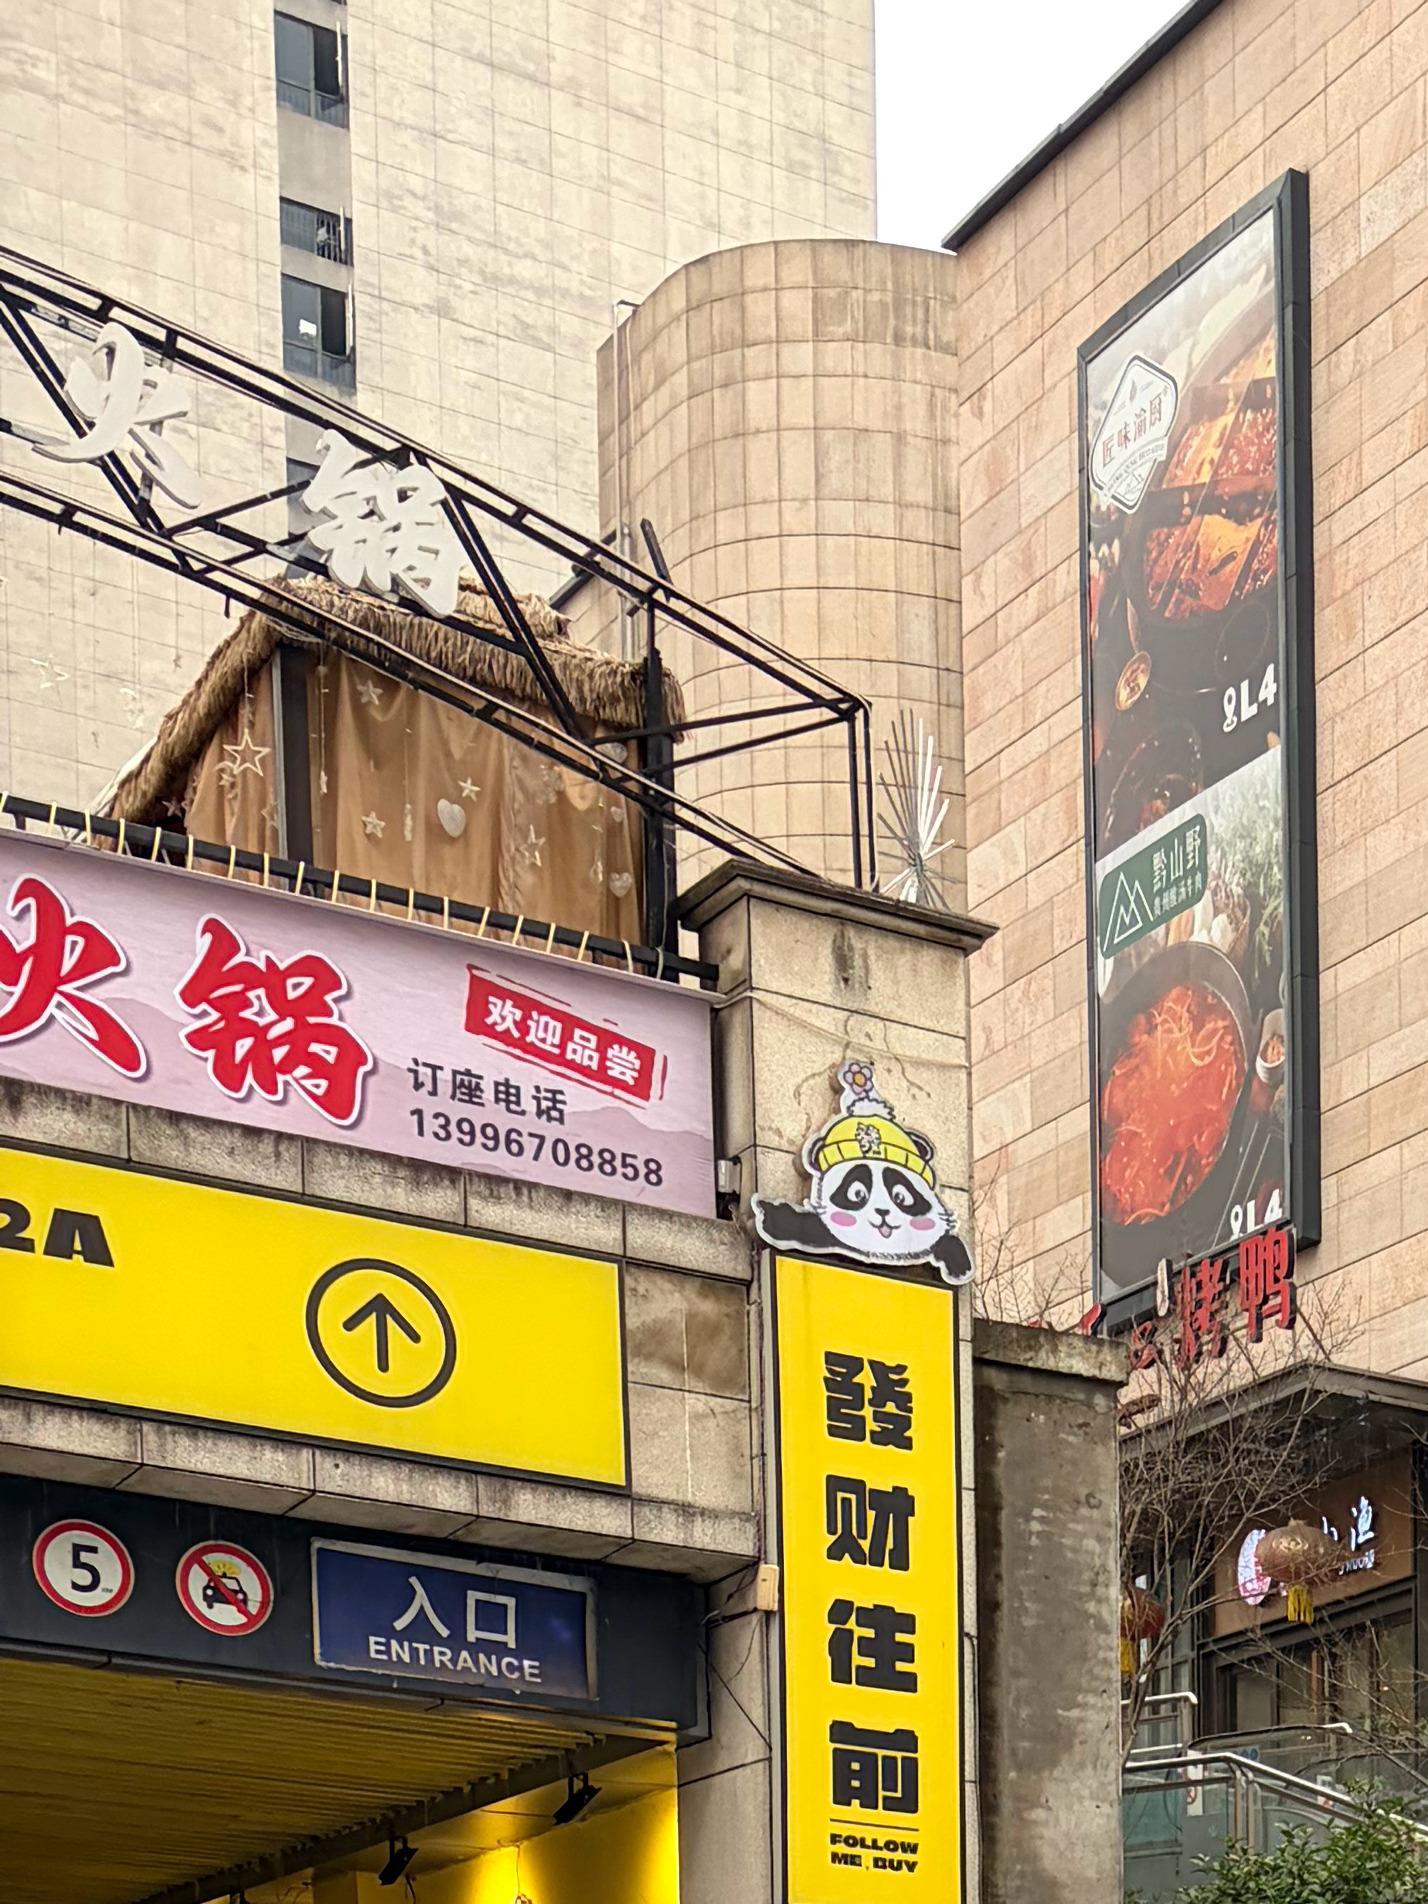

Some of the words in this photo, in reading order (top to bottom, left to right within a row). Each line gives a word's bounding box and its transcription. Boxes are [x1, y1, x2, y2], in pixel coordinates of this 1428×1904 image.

[31, 320, 463, 619] 火锅
[0, 876, 376, 1128] 火锅
[485, 996, 641, 1086] 欢迎品尝
[406, 1058, 567, 1125] 订座电话
[409, 1107, 664, 1187] 13996708858
[70, 1543, 102, 1593] 5
[822, 1350, 919, 1814] 發财往前
[393, 1576, 518, 1648] 入口
[368, 1635, 542, 1683] ENTRANCE
[829, 1833, 919, 1855] FOLLOW
[872, 1856, 918, 1873] BUY
